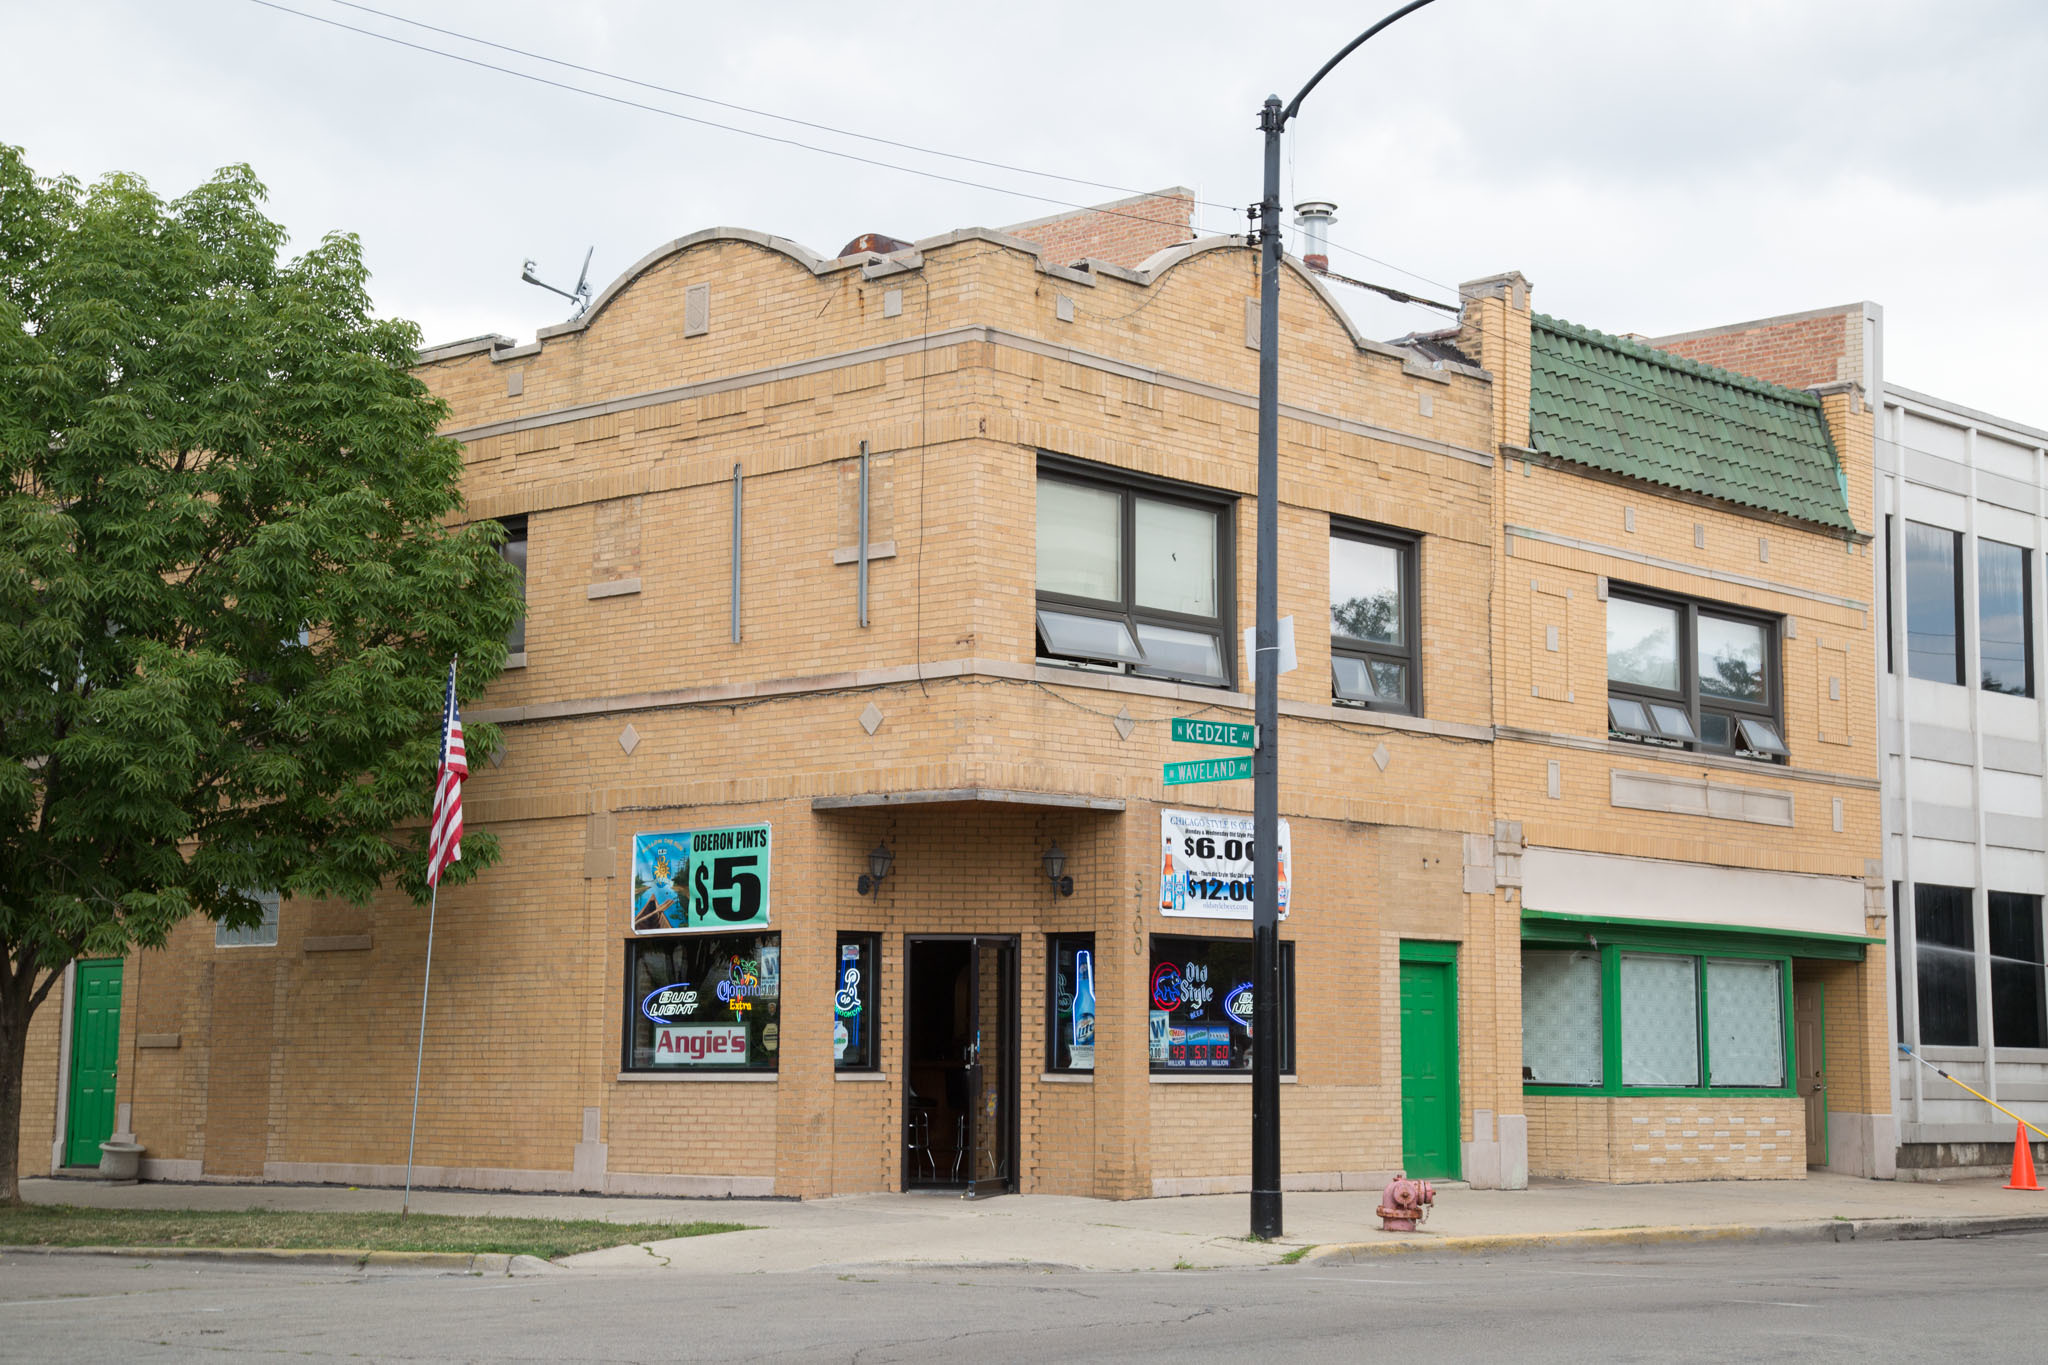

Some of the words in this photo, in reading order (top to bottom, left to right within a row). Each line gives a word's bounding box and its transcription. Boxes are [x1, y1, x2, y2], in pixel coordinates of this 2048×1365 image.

[1177, 726, 1183, 735] N
[1186, 722, 1238, 744] KEDZIE
[1241, 731, 1250, 741] AV
[1178, 760, 1236, 780] WAVELAND
[1239, 763, 1248, 773] AV
[1170, 816, 1205, 827] CHICAGO
[1206, 818, 1229, 830] STYLE
[1230, 821, 1238, 829] IS
[693, 831, 734, 852] OBERON
[736, 829, 767, 849] PINTS
[1205, 830, 1229, 838] Wednesday
[695, 855, 762, 922] $5
[1185, 961, 1208, 983] Old
[659, 990, 697, 1004] BUD
[716, 980, 761, 1003] Corona
[1180, 979, 1214, 1010] Style
[649, 1003, 699, 1017] LIGHT
[729, 998, 752, 1011] Extra
[1231, 1002, 1254, 1014] LIG
[1189, 1009, 1204, 1020] BEER
[656, 1029, 746, 1060] Angie's
[1172, 1045, 1186, 1059] 43
[1194, 1045, 1207, 1059] 57
[1215, 1045, 1229, 1059] 60
